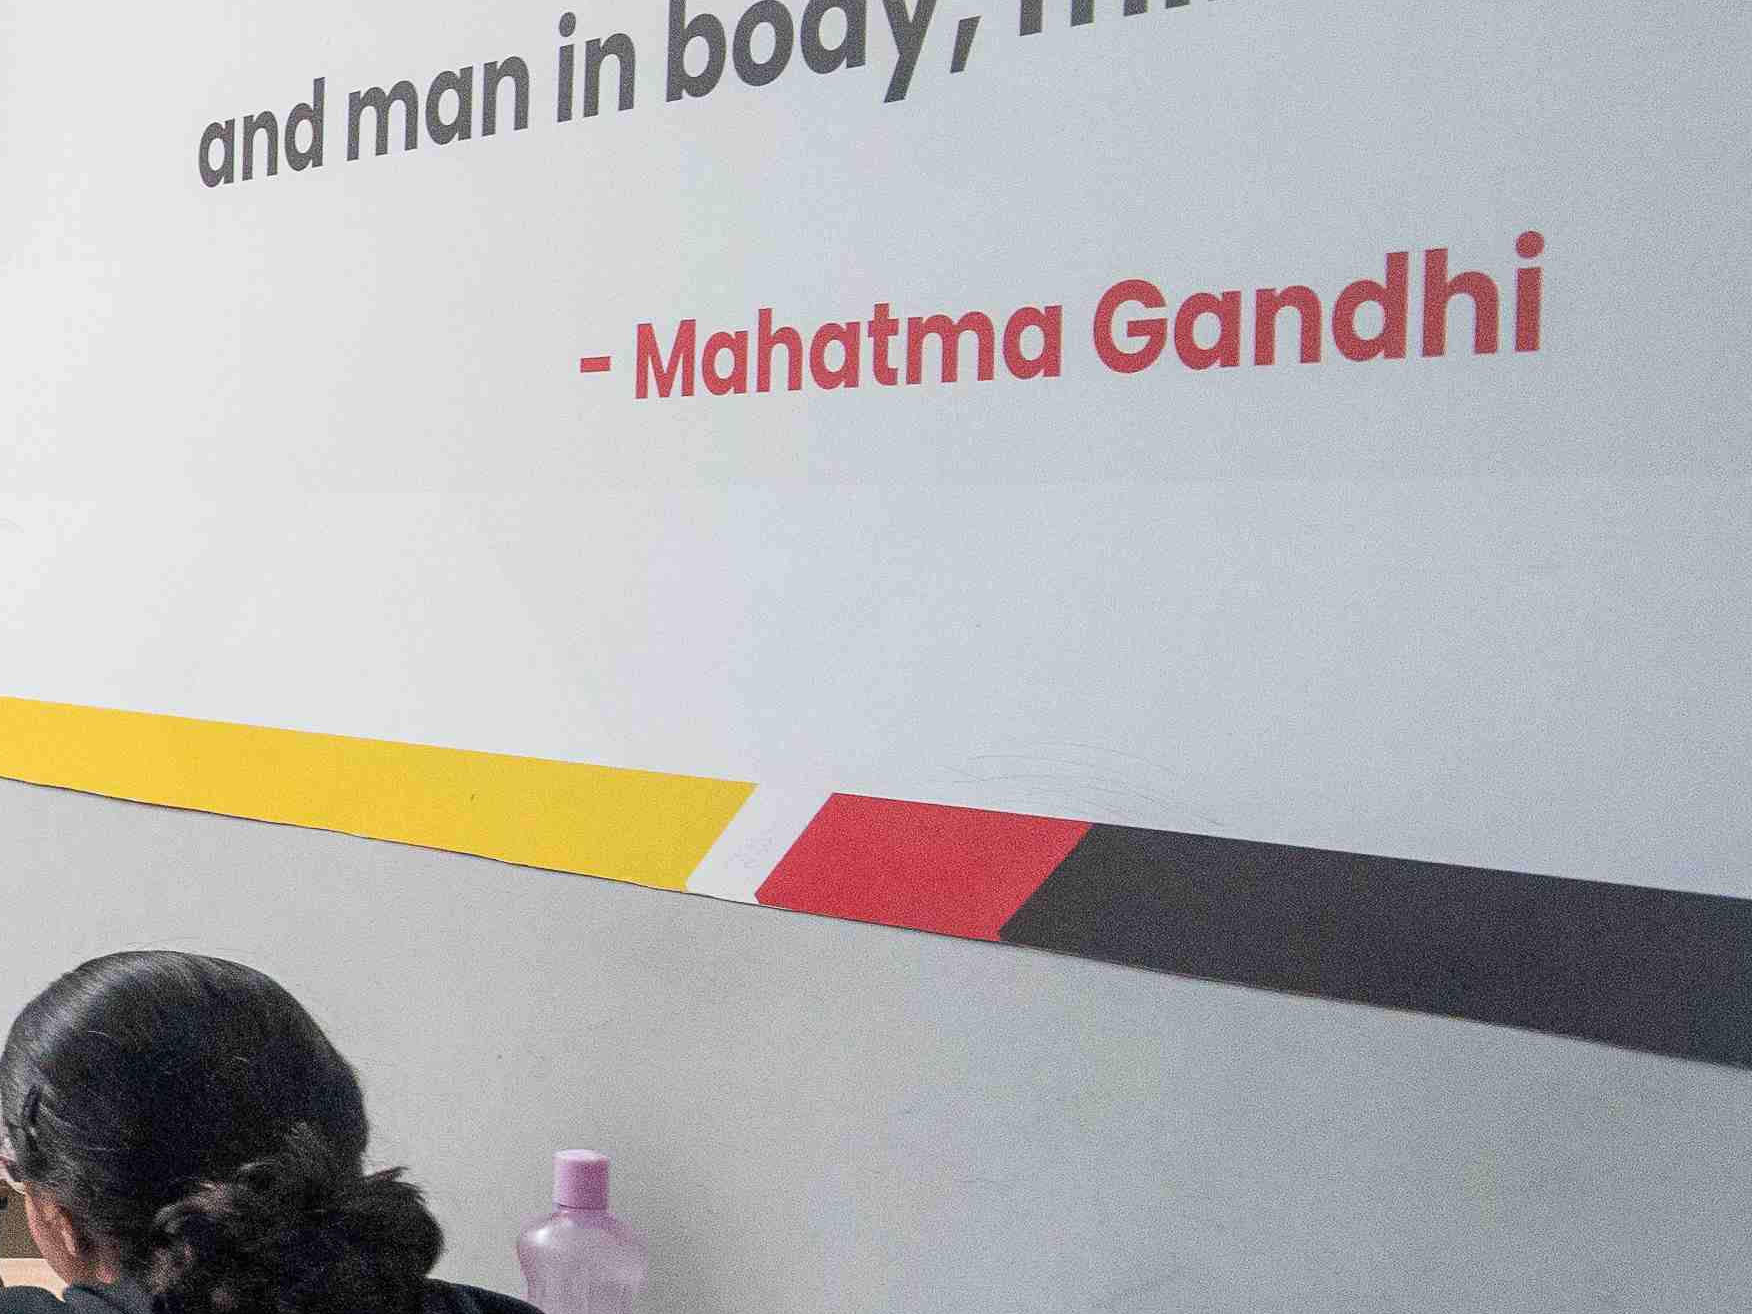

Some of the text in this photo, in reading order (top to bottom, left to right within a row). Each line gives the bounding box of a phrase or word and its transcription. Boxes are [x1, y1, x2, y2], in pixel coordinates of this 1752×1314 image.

[199, 77, 325, 188] and
[347, 56, 529, 161] man
[557, 12, 635, 122] in
[636, 303, 1062, 399] Mahatma
[1093, 231, 1544, 374] Gandhi
